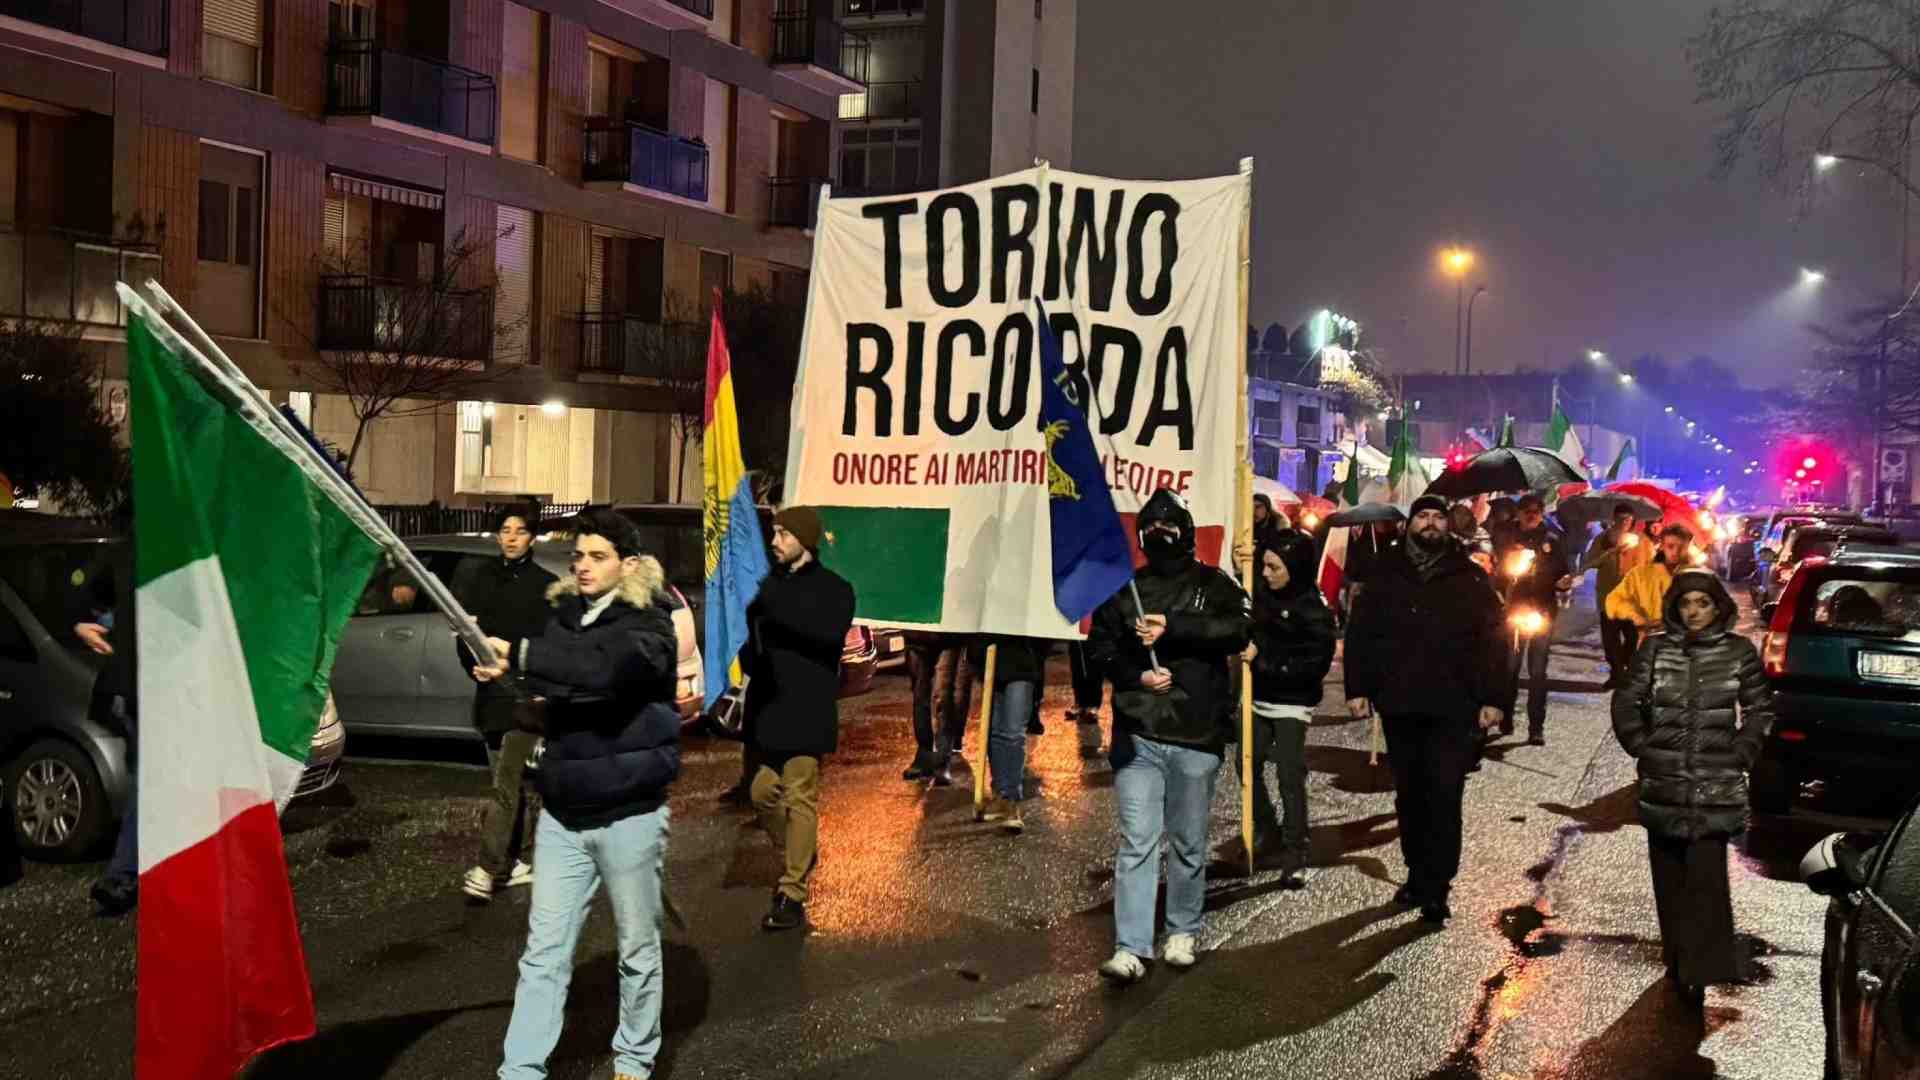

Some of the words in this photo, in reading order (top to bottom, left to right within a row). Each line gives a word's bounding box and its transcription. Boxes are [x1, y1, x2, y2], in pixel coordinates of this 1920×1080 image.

[862, 183, 1181, 316] TORINO
[842, 312, 1194, 451] RICORDA
[832, 452, 919, 486] ONORE
[924, 452, 949, 486] AI
[955, 449, 1046, 486] MARTIRI
